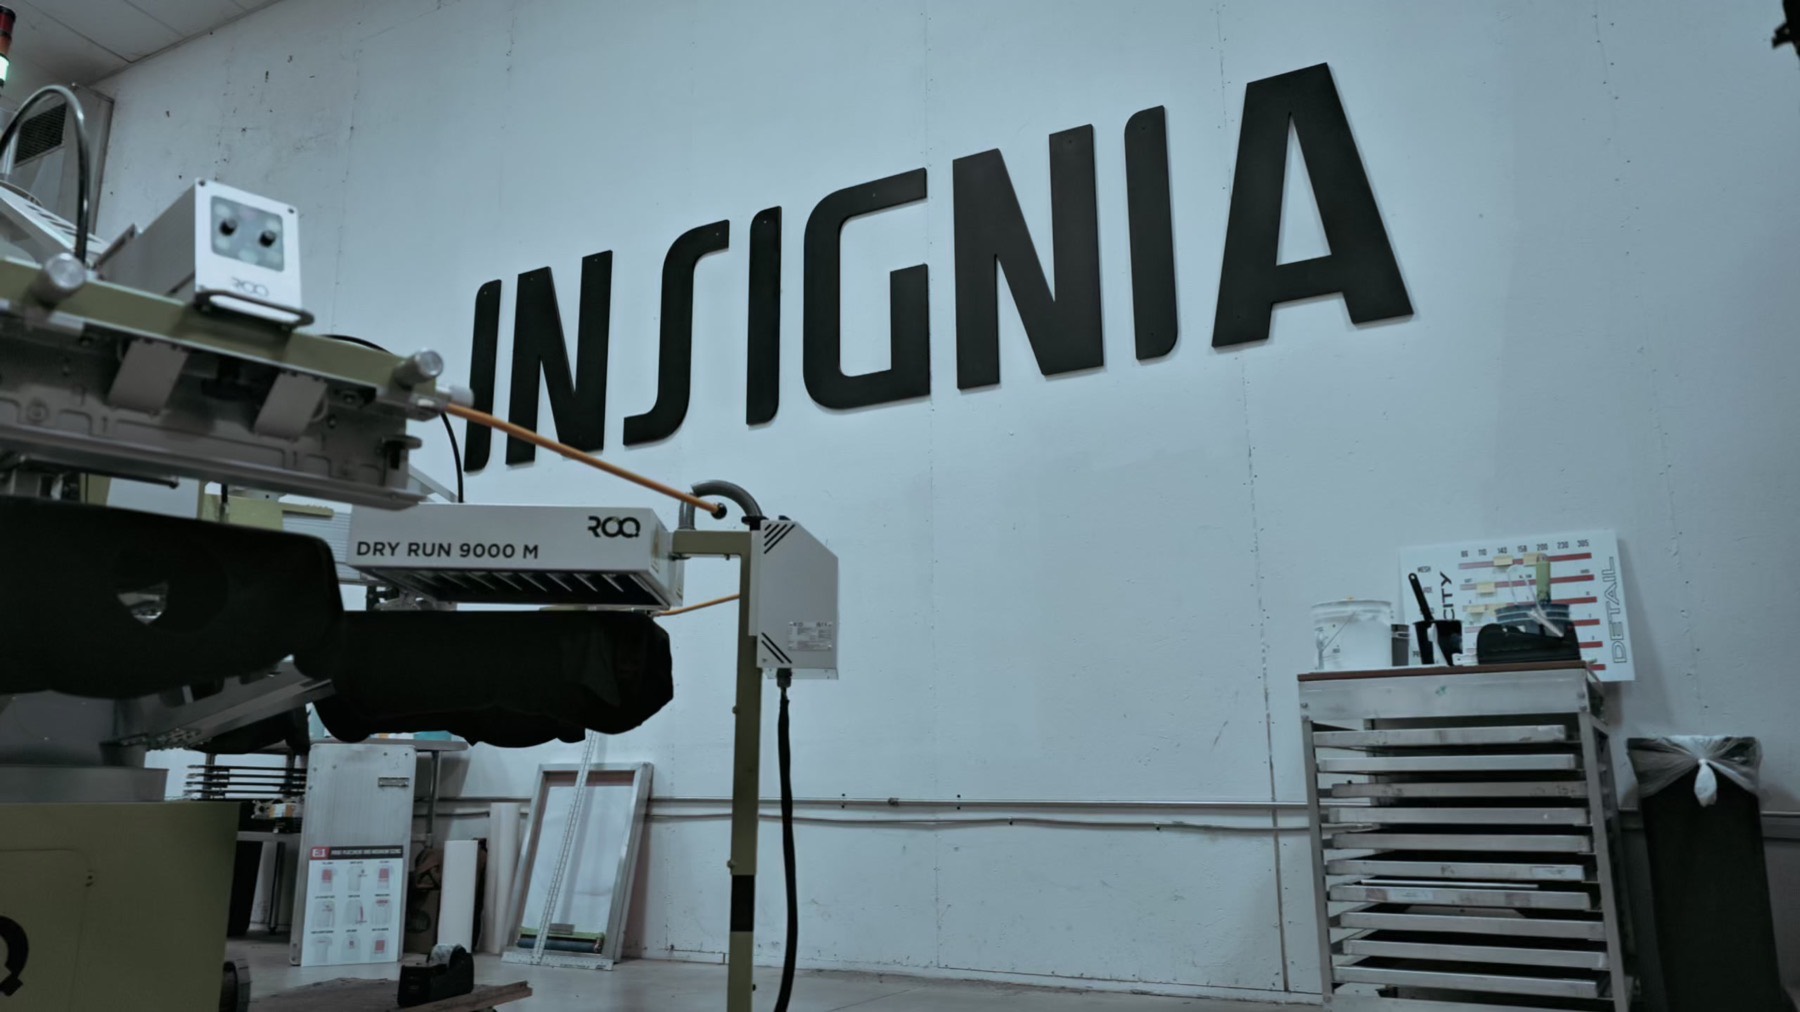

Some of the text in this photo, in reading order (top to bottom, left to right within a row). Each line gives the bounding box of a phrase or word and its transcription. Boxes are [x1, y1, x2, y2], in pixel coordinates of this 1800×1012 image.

[463, 62, 1415, 472] INSIGNIA
[587, 516, 641, 538] ROQ
[356, 541, 539, 559] DRY RUN 9000 M
[1536, 543, 1549, 551] 200
[1557, 541, 1569, 549] 230
[1601, 556, 1628, 664] DETAIL
